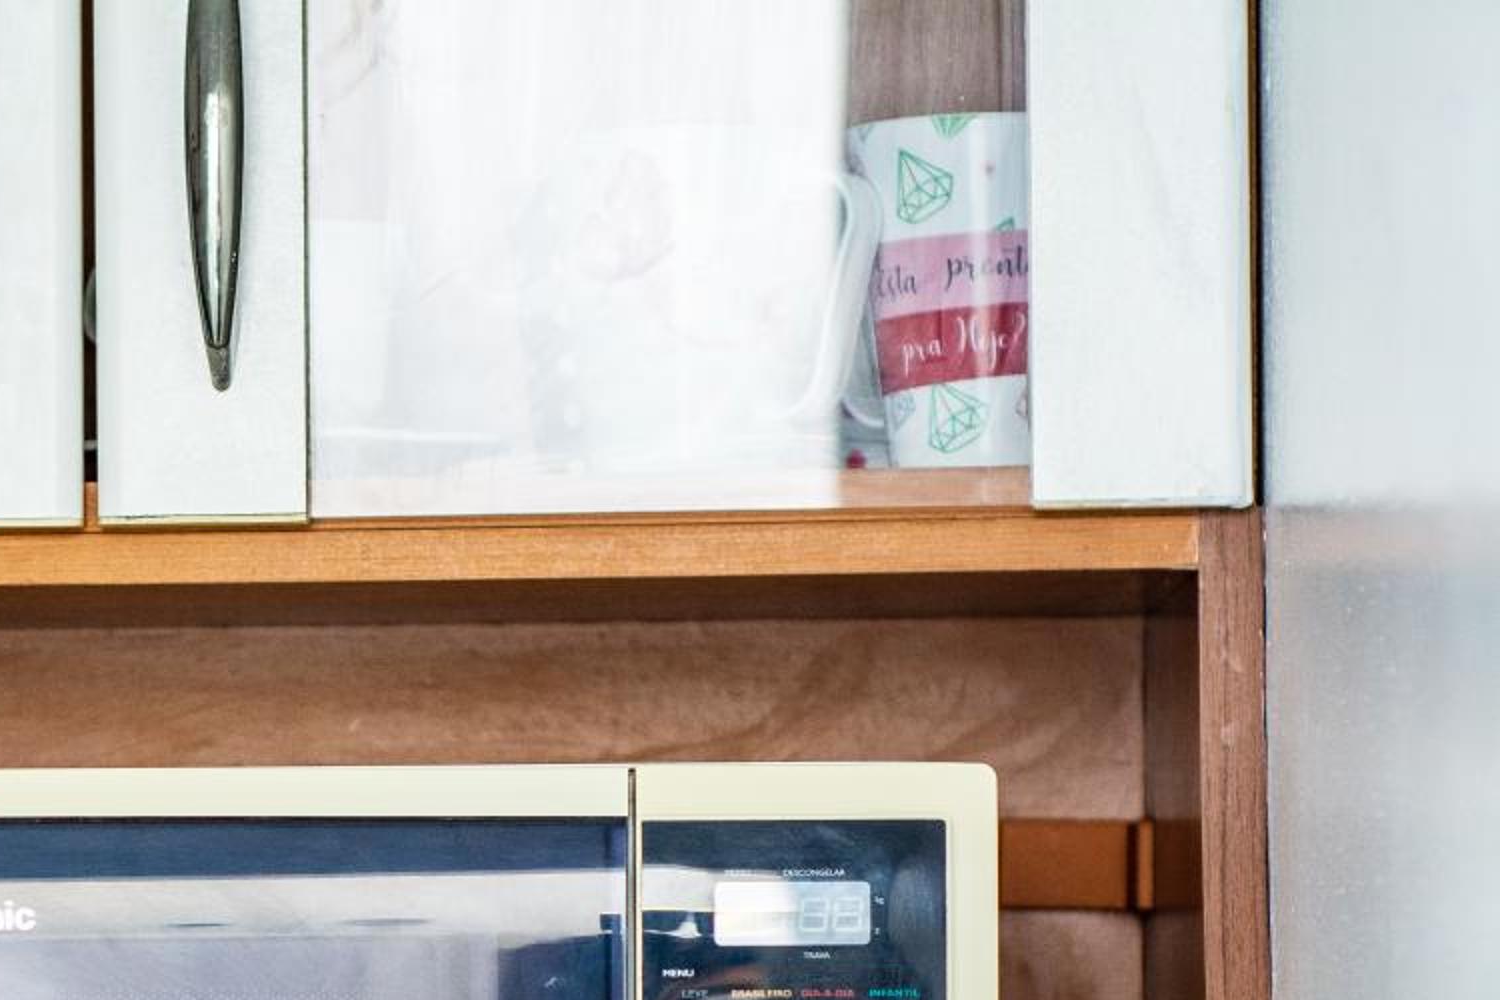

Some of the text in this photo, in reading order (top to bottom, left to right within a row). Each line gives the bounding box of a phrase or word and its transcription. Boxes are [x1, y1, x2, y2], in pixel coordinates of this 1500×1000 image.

[900, 337, 943, 377] pra
[661, 968, 695, 978] MENU
[868, 988, 919, 998] INFANTIL
